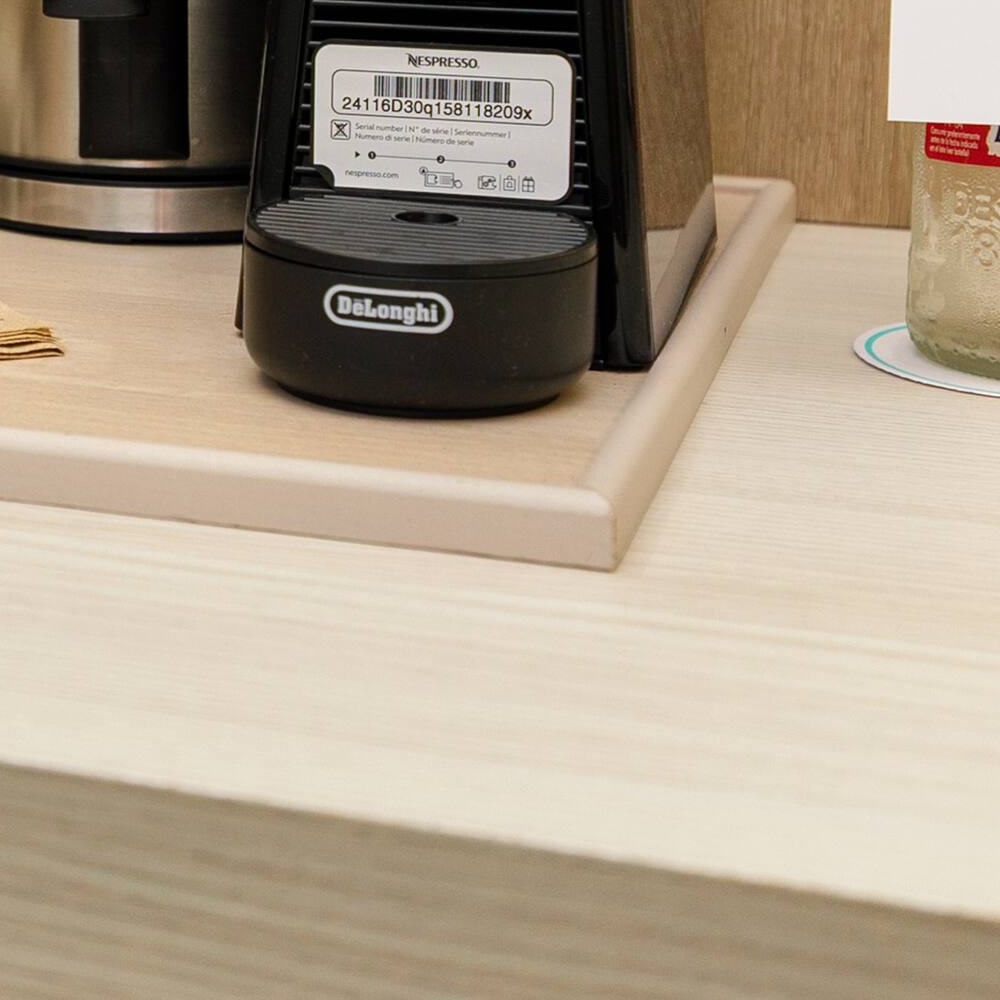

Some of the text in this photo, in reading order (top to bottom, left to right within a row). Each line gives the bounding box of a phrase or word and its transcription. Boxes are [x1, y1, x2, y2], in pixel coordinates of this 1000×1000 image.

[406, 53, 479, 69] NESPRESSO
[342, 96, 533, 120] 24116D30q158118209x
[355, 122, 375, 130] Serial
[376, 124, 404, 133] number
[455, 129, 507, 138] Seriennummer
[355, 133, 384, 141] Numero
[344, 169, 400, 179] nespresso.com
